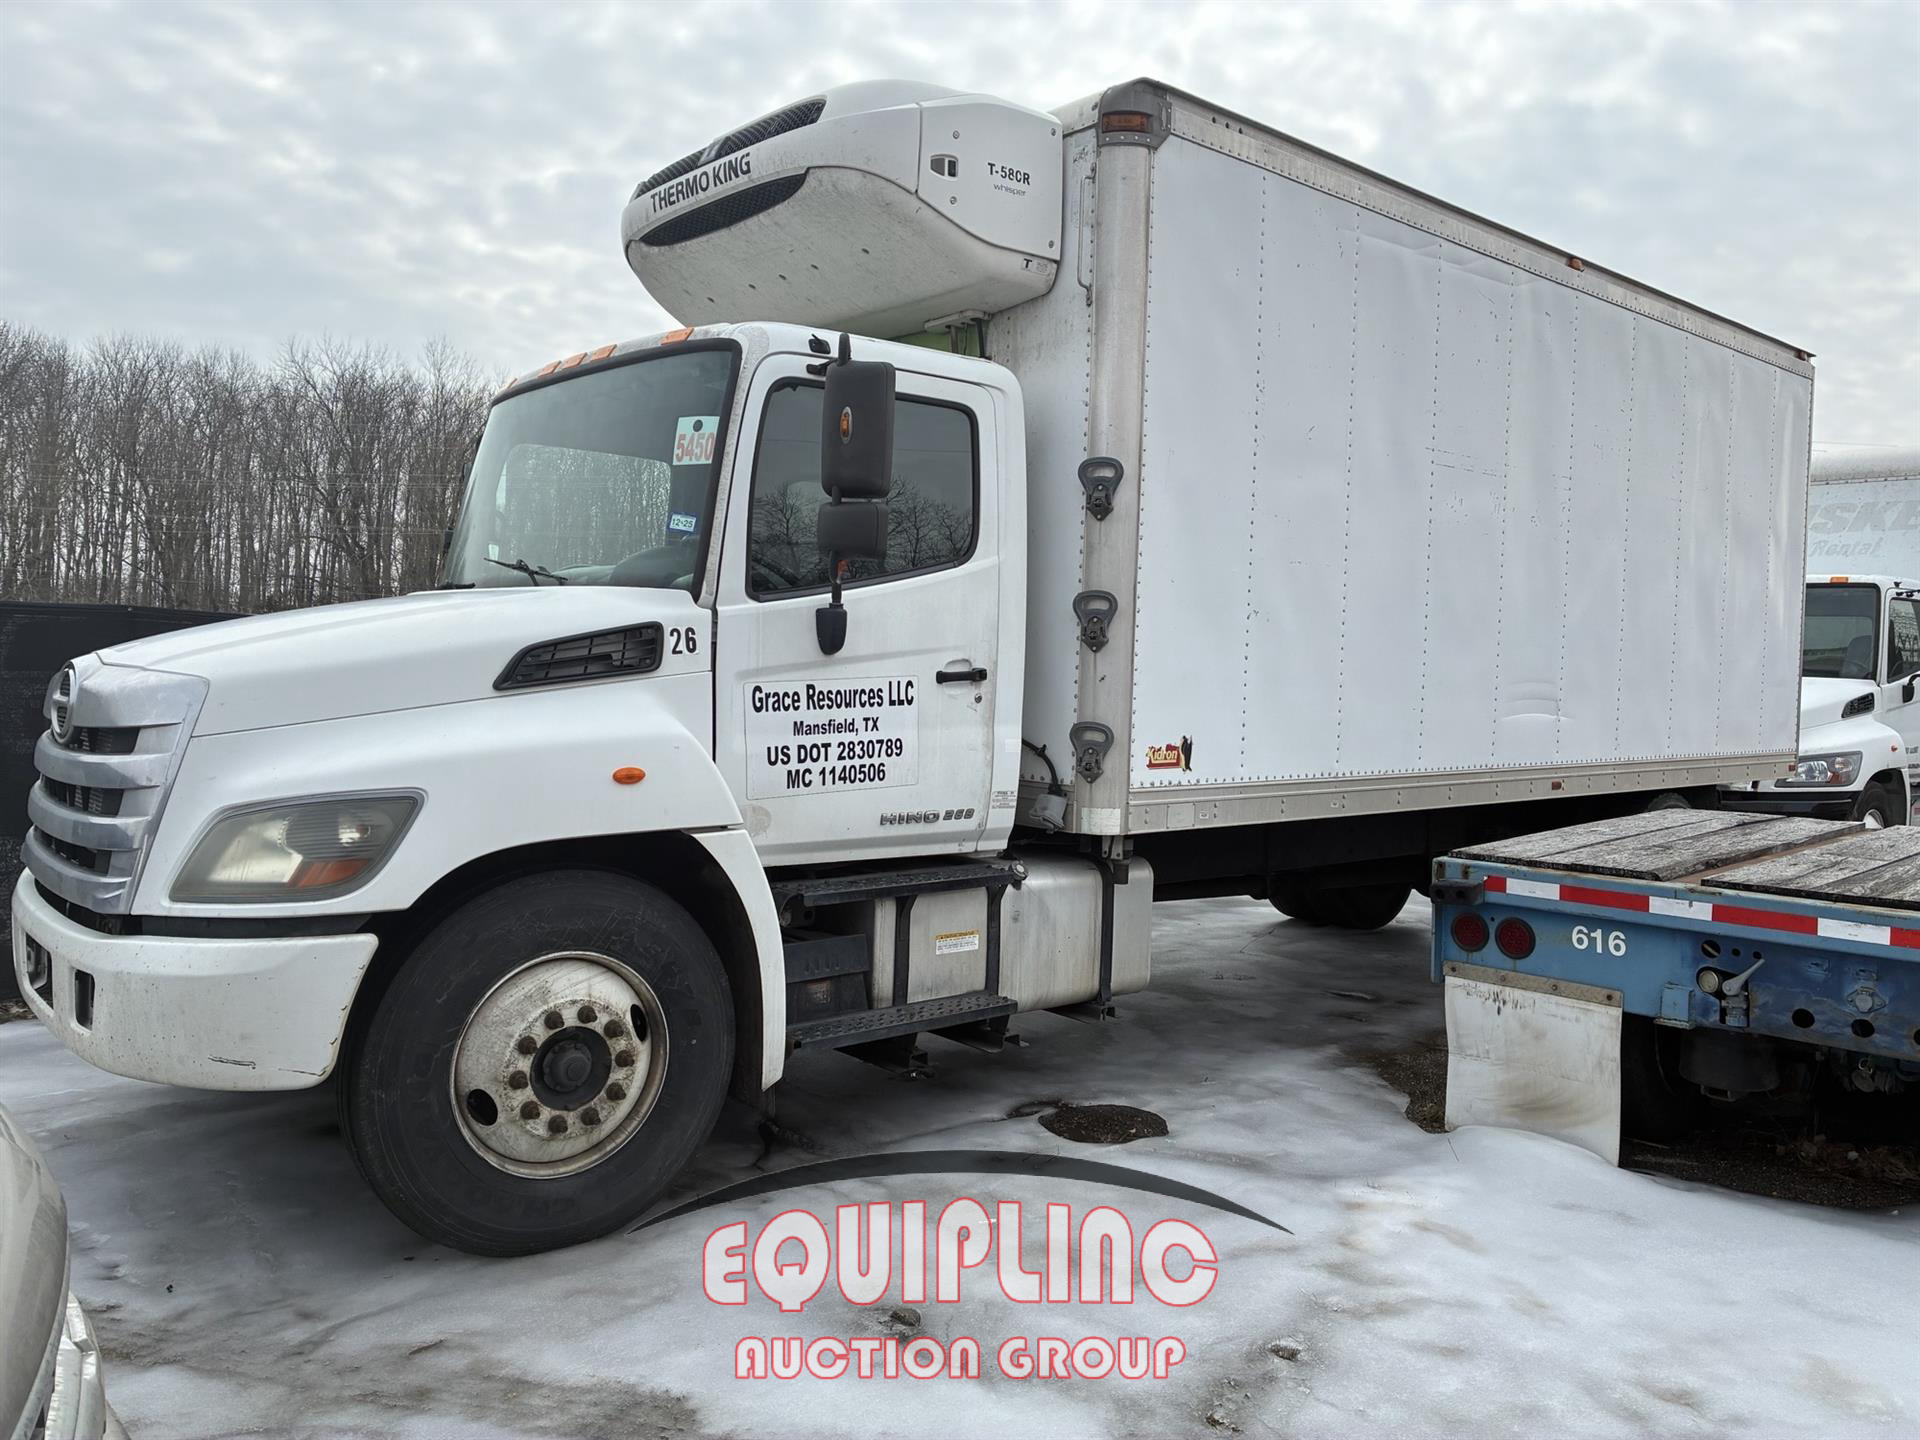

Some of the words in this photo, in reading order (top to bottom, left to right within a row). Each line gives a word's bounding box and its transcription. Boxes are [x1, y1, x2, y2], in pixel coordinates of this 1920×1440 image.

[650, 170, 710, 213] THERMO
[712, 152, 752, 188] KING
[675, 432, 715, 462] 5450
[669, 626, 697, 655] 26
[751, 684, 801, 714] Grace
[805, 684, 884, 711] Resources
[888, 679, 914, 707] LLC
[793, 717, 859, 737] Mansfield,
[862, 716, 880, 733] TX
[766, 744, 791, 766] US
[797, 742, 832, 764] DOT
[836, 737, 903, 761] 2830789
[1145, 746, 1178, 761] Kidron
[786, 767, 813, 789] MC
[818, 762, 886, 786] 1140506
[880, 810, 940, 826] HINO
[1571, 925, 1627, 957] 616
